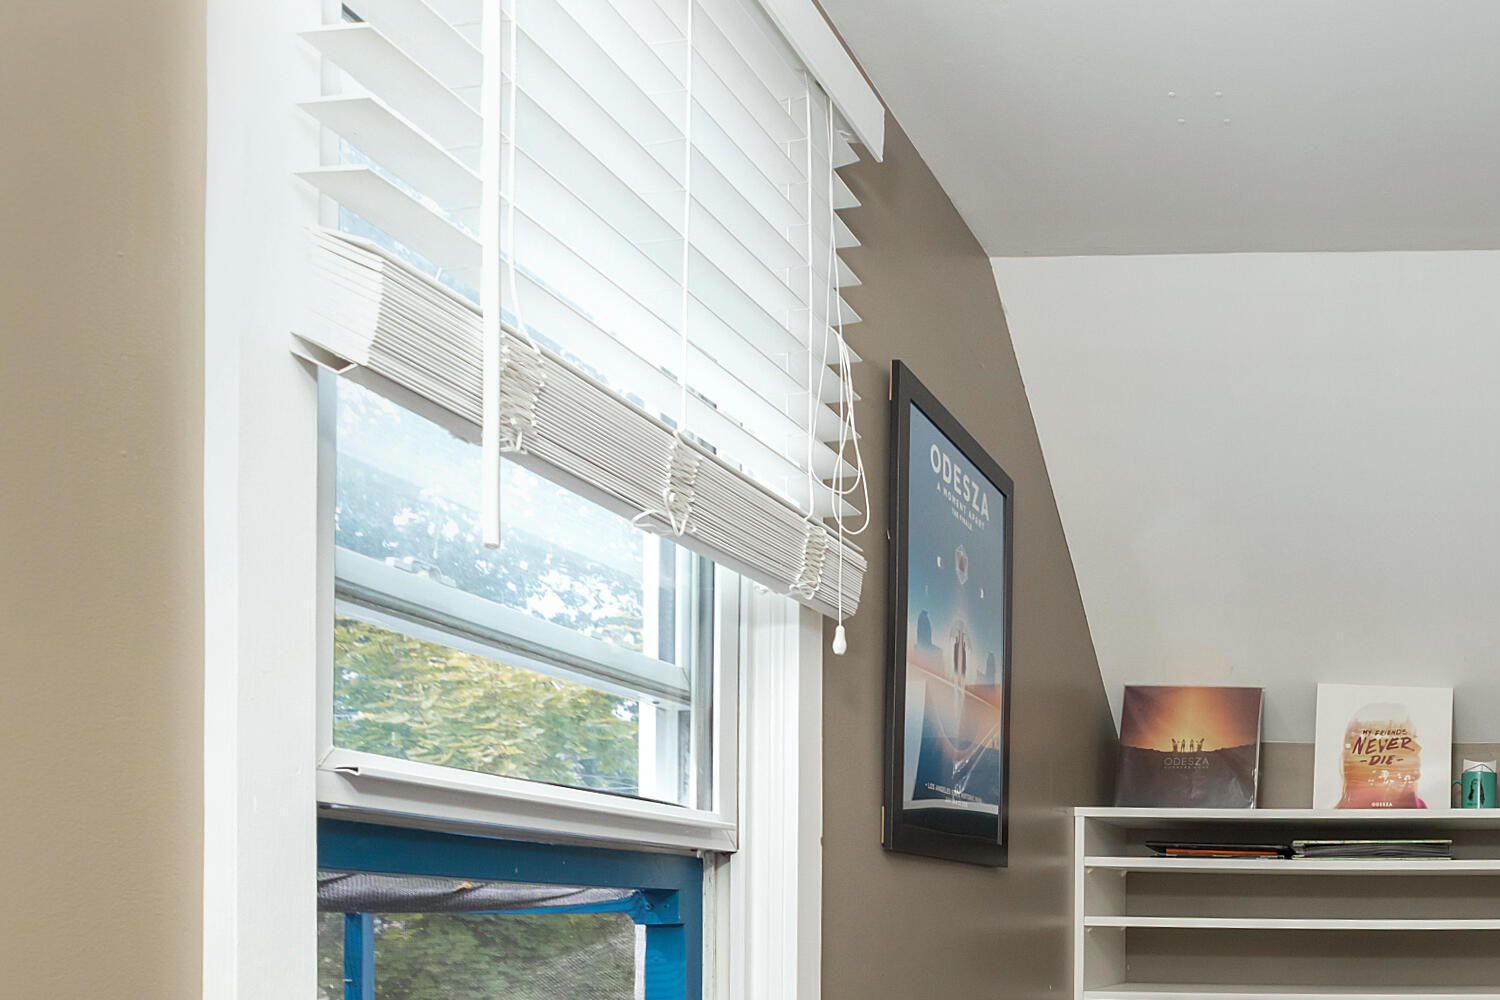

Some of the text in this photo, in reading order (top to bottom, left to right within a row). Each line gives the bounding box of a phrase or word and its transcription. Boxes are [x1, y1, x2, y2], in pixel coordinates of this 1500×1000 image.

[930, 444, 990, 521] ODESZA
[1352, 736, 1415, 755] NEVER
[1163, 757, 1209, 766] ODESZA
